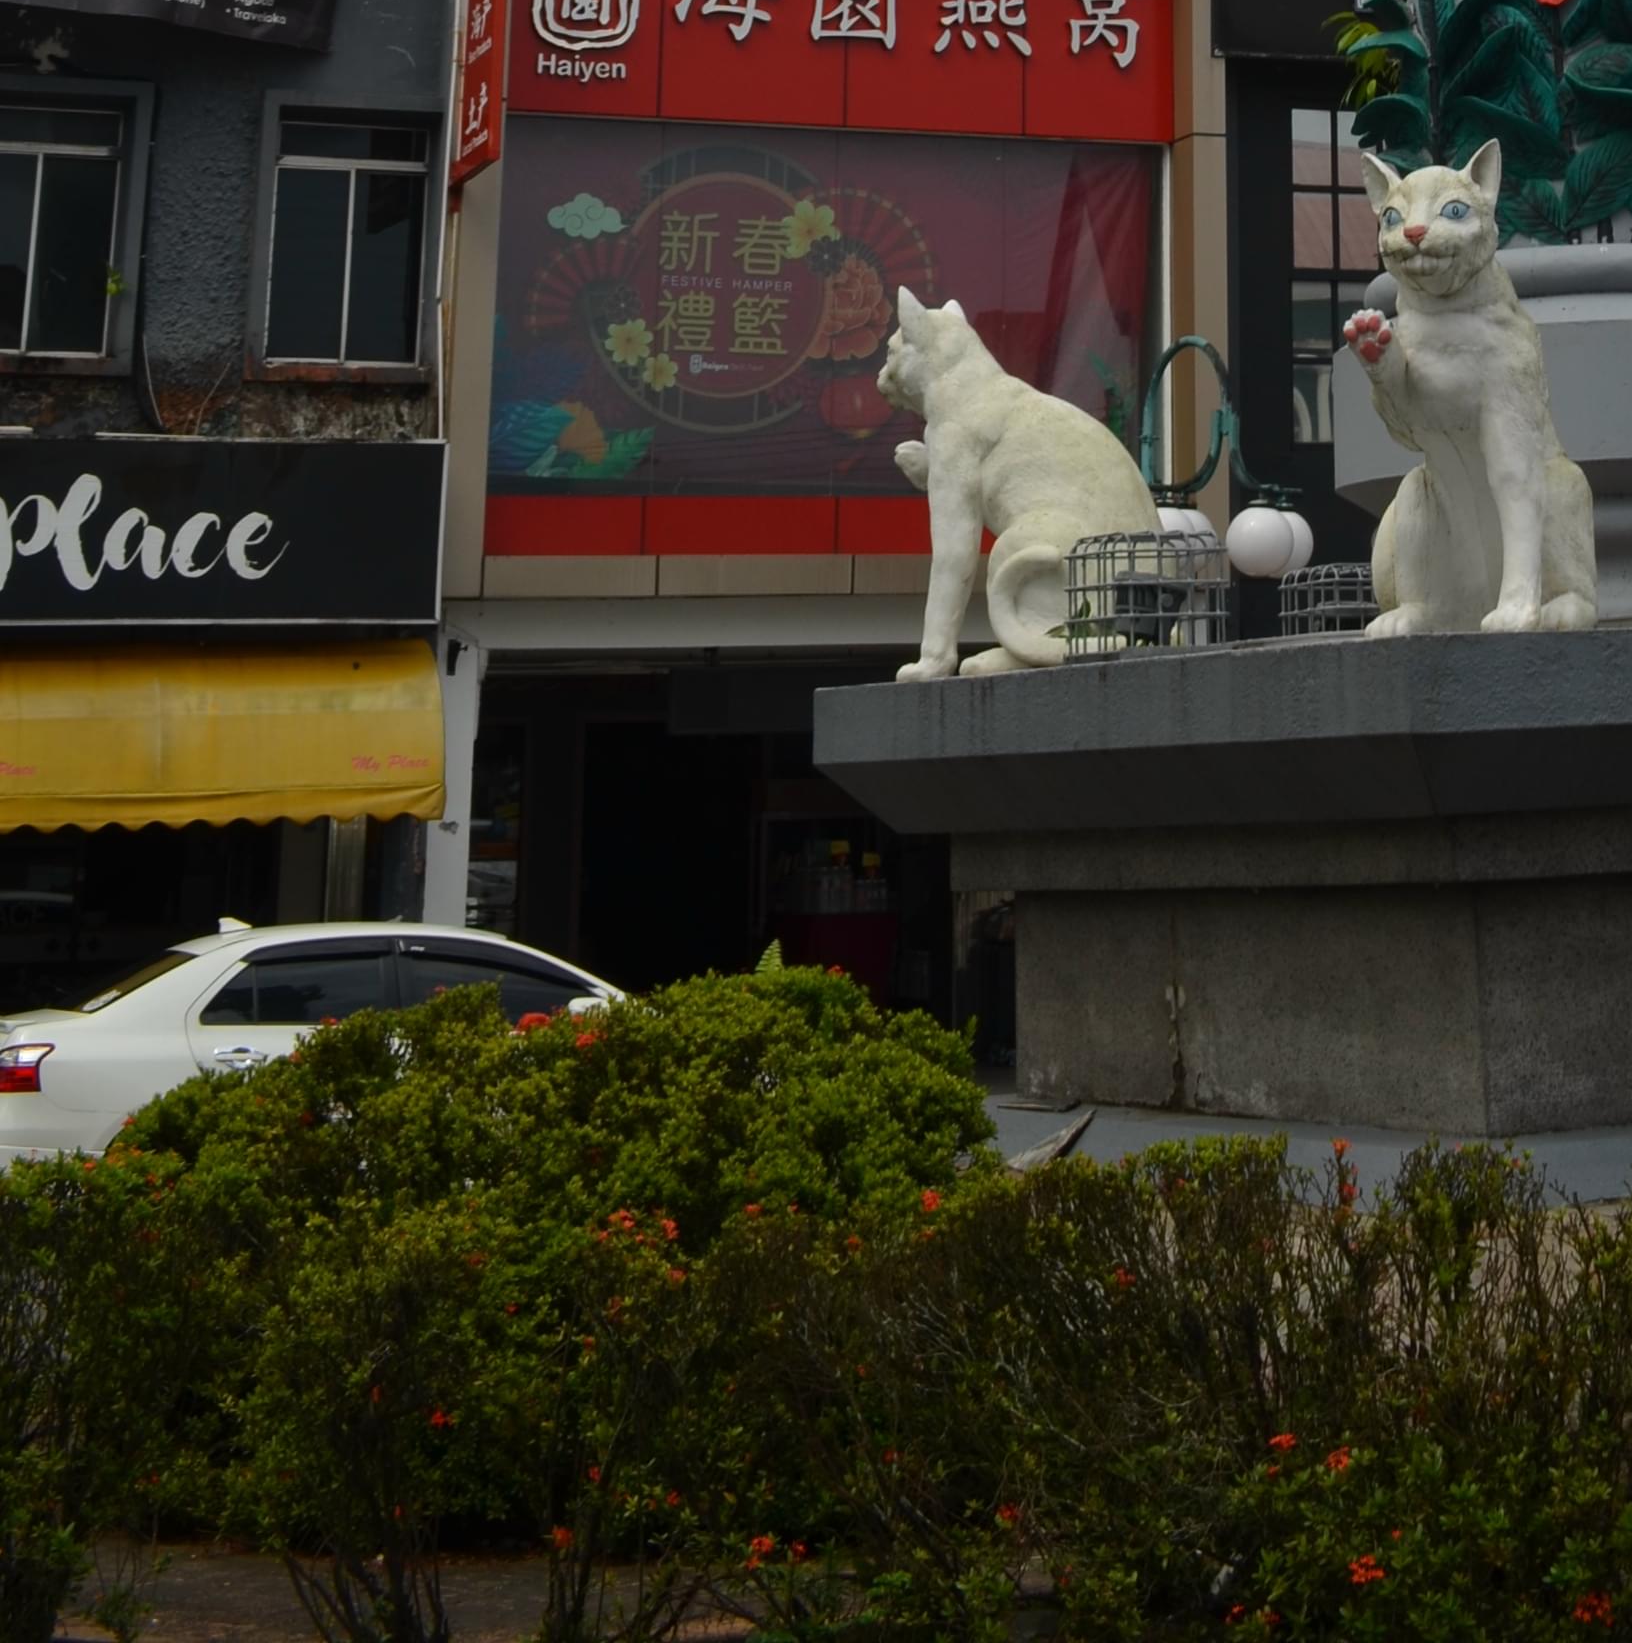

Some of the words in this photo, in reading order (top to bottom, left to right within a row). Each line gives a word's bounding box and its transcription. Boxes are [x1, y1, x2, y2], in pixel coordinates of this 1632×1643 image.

[537, 52, 627, 83] Haiyen
[661, 274, 723, 290] FESTIVE
[732, 278, 793, 292] HAMPER
[352, 756, 380, 773] My
[387, 754, 430, 770] Place
